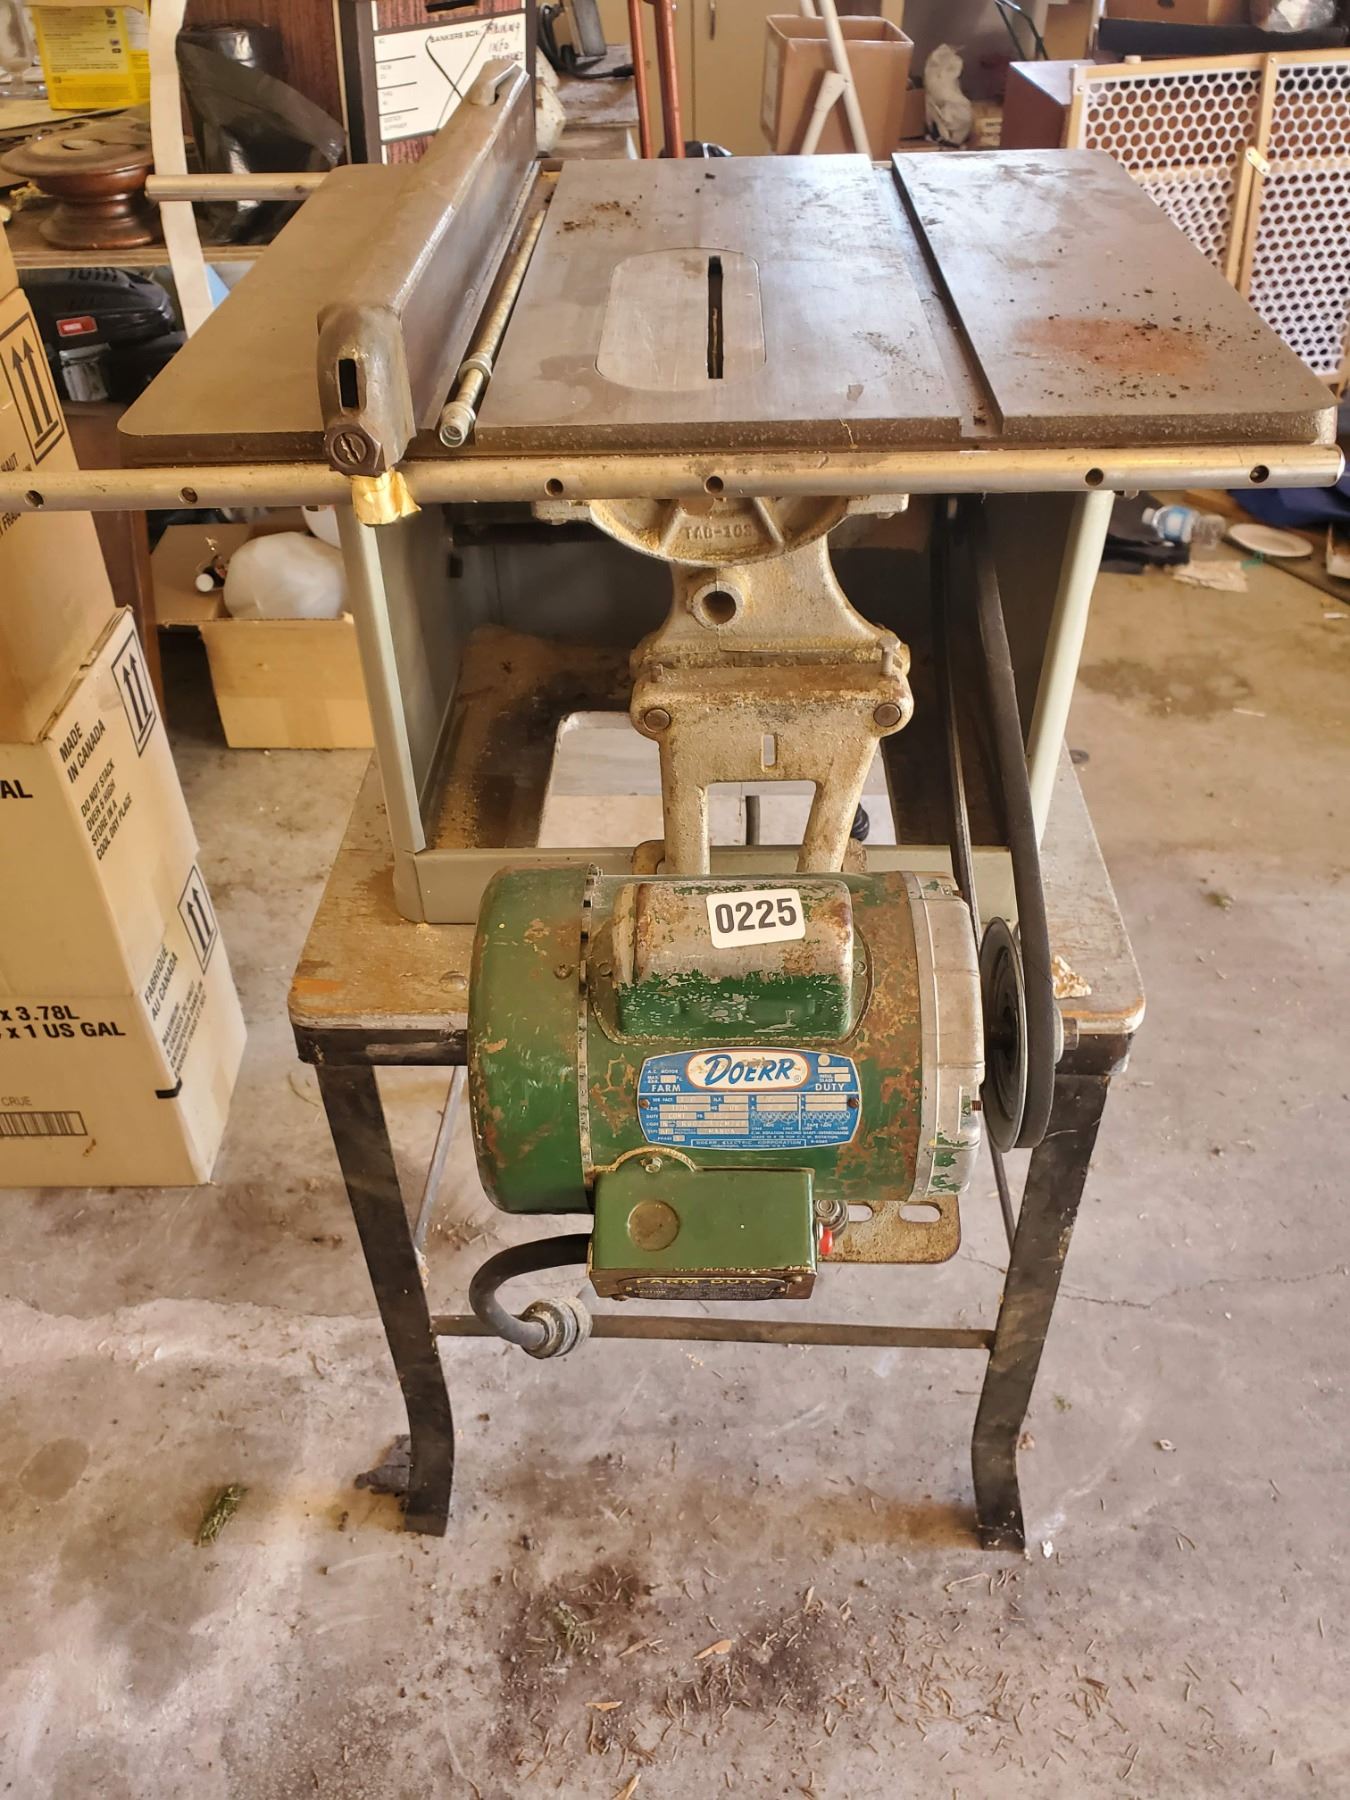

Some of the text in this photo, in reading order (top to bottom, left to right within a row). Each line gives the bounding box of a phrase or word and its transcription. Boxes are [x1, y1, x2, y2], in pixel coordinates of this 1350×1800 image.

[59, 721, 83, 763] MADE
[67, 718, 106, 784] IN CANADA
[81, 758, 115, 817] DO NOT STACK
[86, 805, 102, 832] OVER
[91, 814, 109, 846] STORE
[106, 804, 114, 818] IN
[97, 835, 111, 861] COOL
[109, 816, 120, 838] DRY
[715, 897, 797, 934] 0225
[152, 952, 178, 1021] AU CANADA
[6, 1027, 20, 1039] x
[24, 1024, 37, 1038] 1
[43, 1023, 75, 1038] US
[80, 1022, 126, 1037] GAL
[15, 1005, 80, 1021] 3.78L
[651, 1084, 681, 1092] FARM
[704, 1054, 796, 1086] DOERR
[815, 1083, 845, 1091] DUTY
